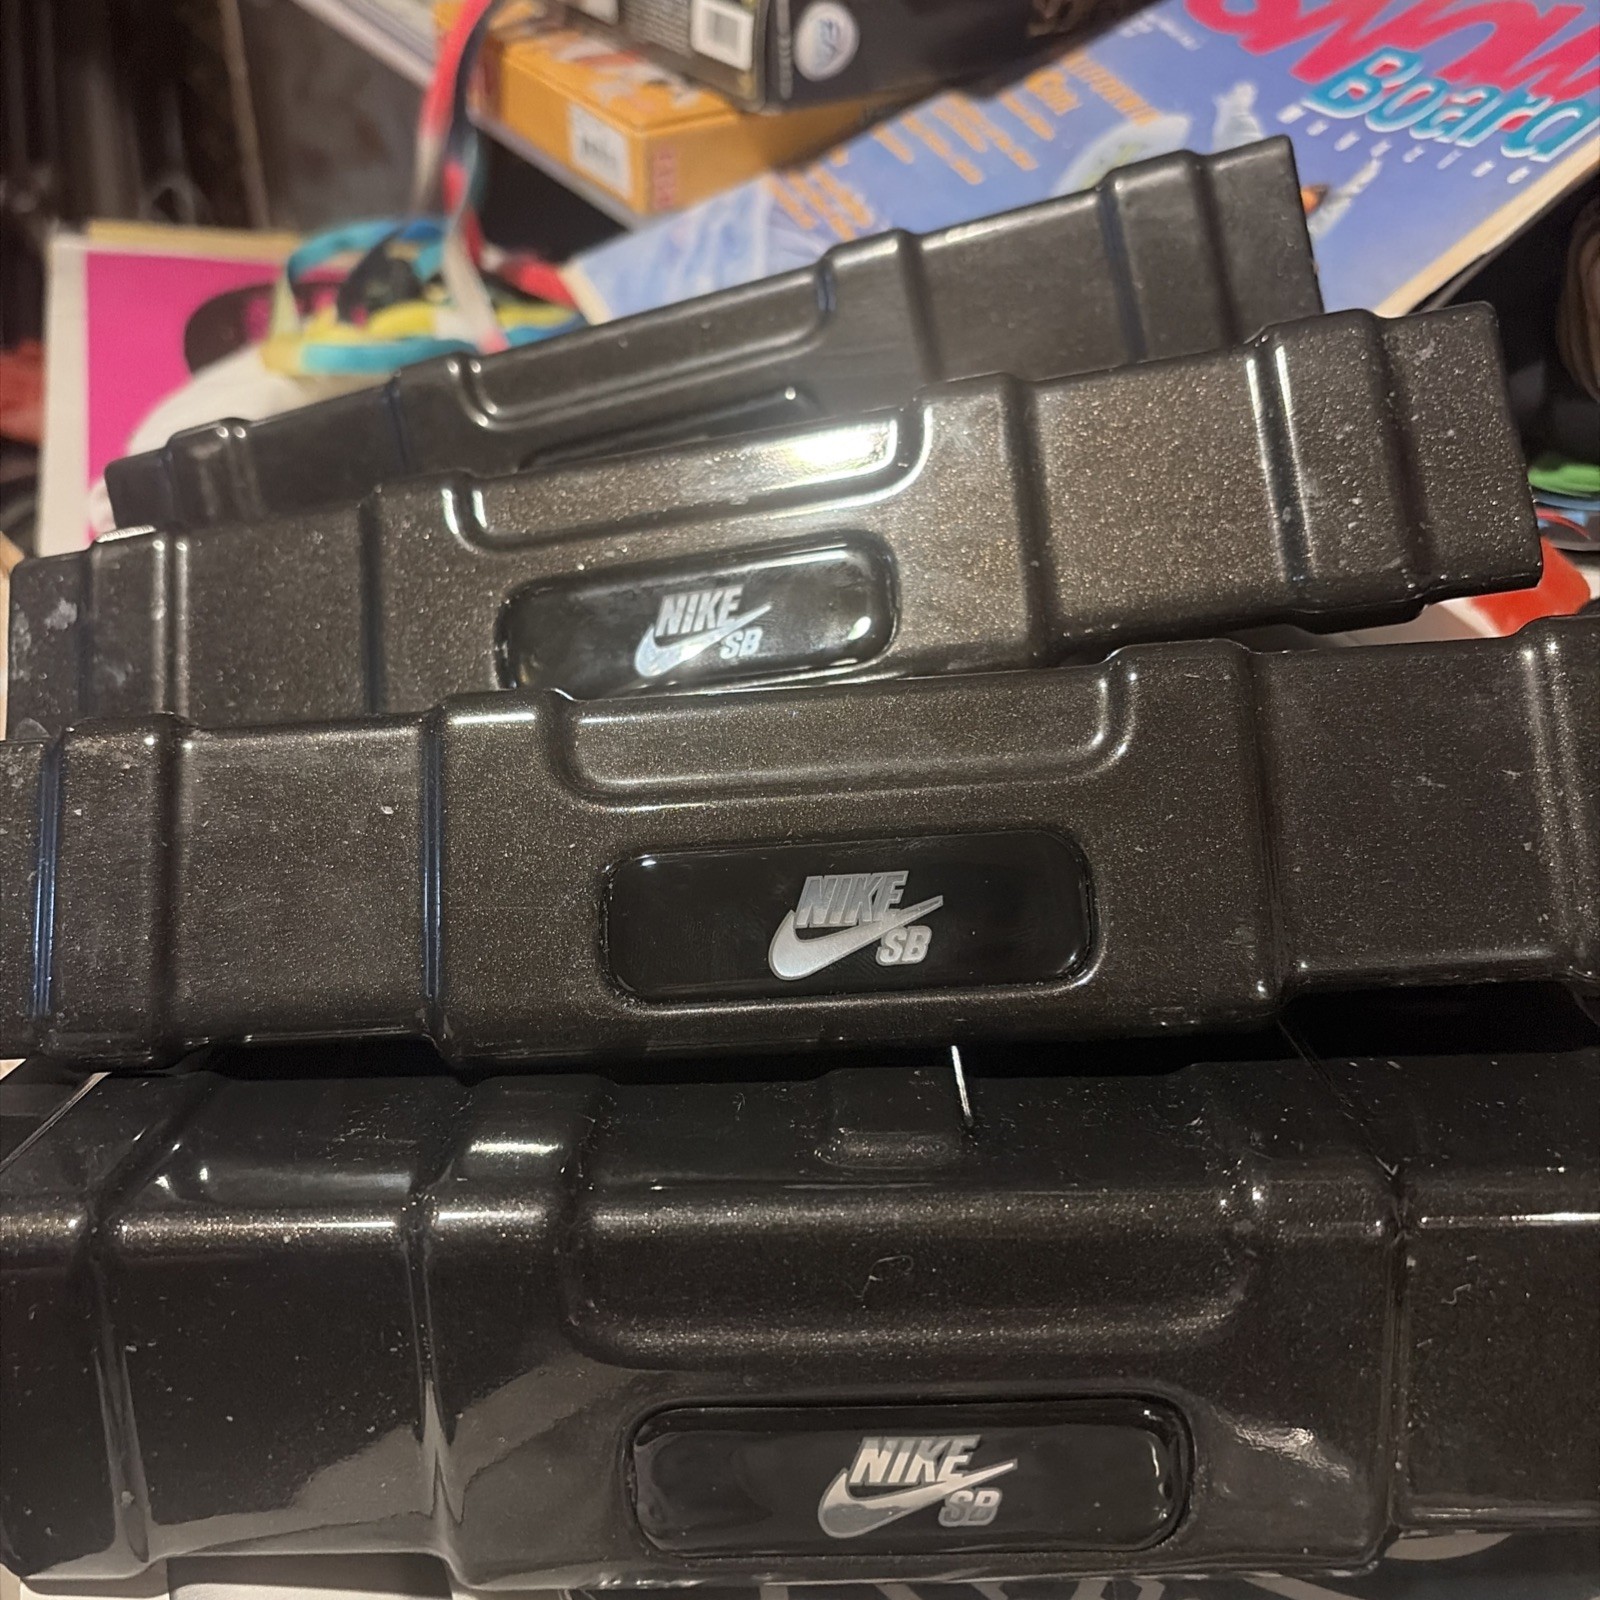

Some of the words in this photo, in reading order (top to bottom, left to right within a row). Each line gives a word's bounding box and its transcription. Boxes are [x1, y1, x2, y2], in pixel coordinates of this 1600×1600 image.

[655, 584, 744, 637] NIKE
[720, 626, 763, 660] SB
[794, 870, 909, 928] NIKE
[875, 925, 932, 966] SB
[850, 1434, 981, 1486] NIKE
[938, 1487, 1003, 1528] SB
